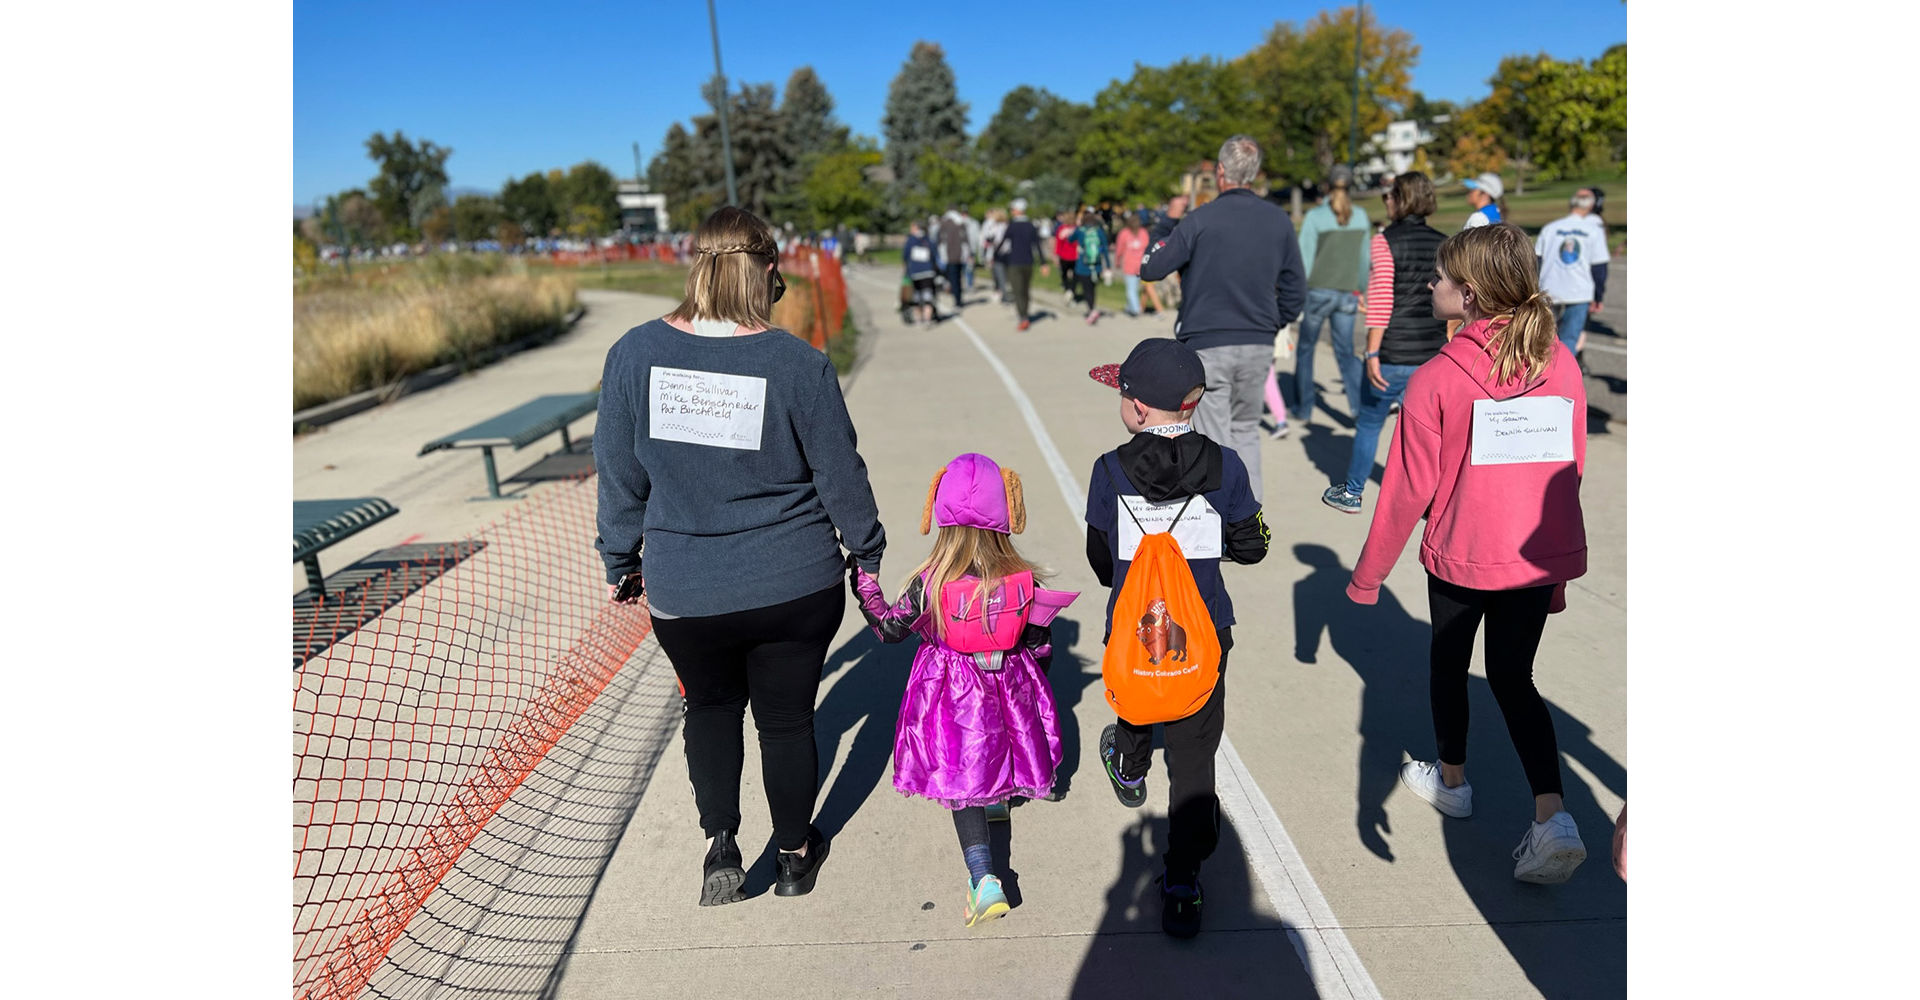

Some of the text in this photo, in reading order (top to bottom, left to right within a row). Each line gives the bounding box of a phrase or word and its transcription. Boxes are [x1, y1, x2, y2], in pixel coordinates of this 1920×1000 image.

[659, 380, 739, 398] Dennis Sullivan
[660, 391, 688, 403] Mike
[661, 403, 676, 414] Pat
[1156, 424, 1189, 434] UNLOCK
[1133, 668, 1154, 677] History
